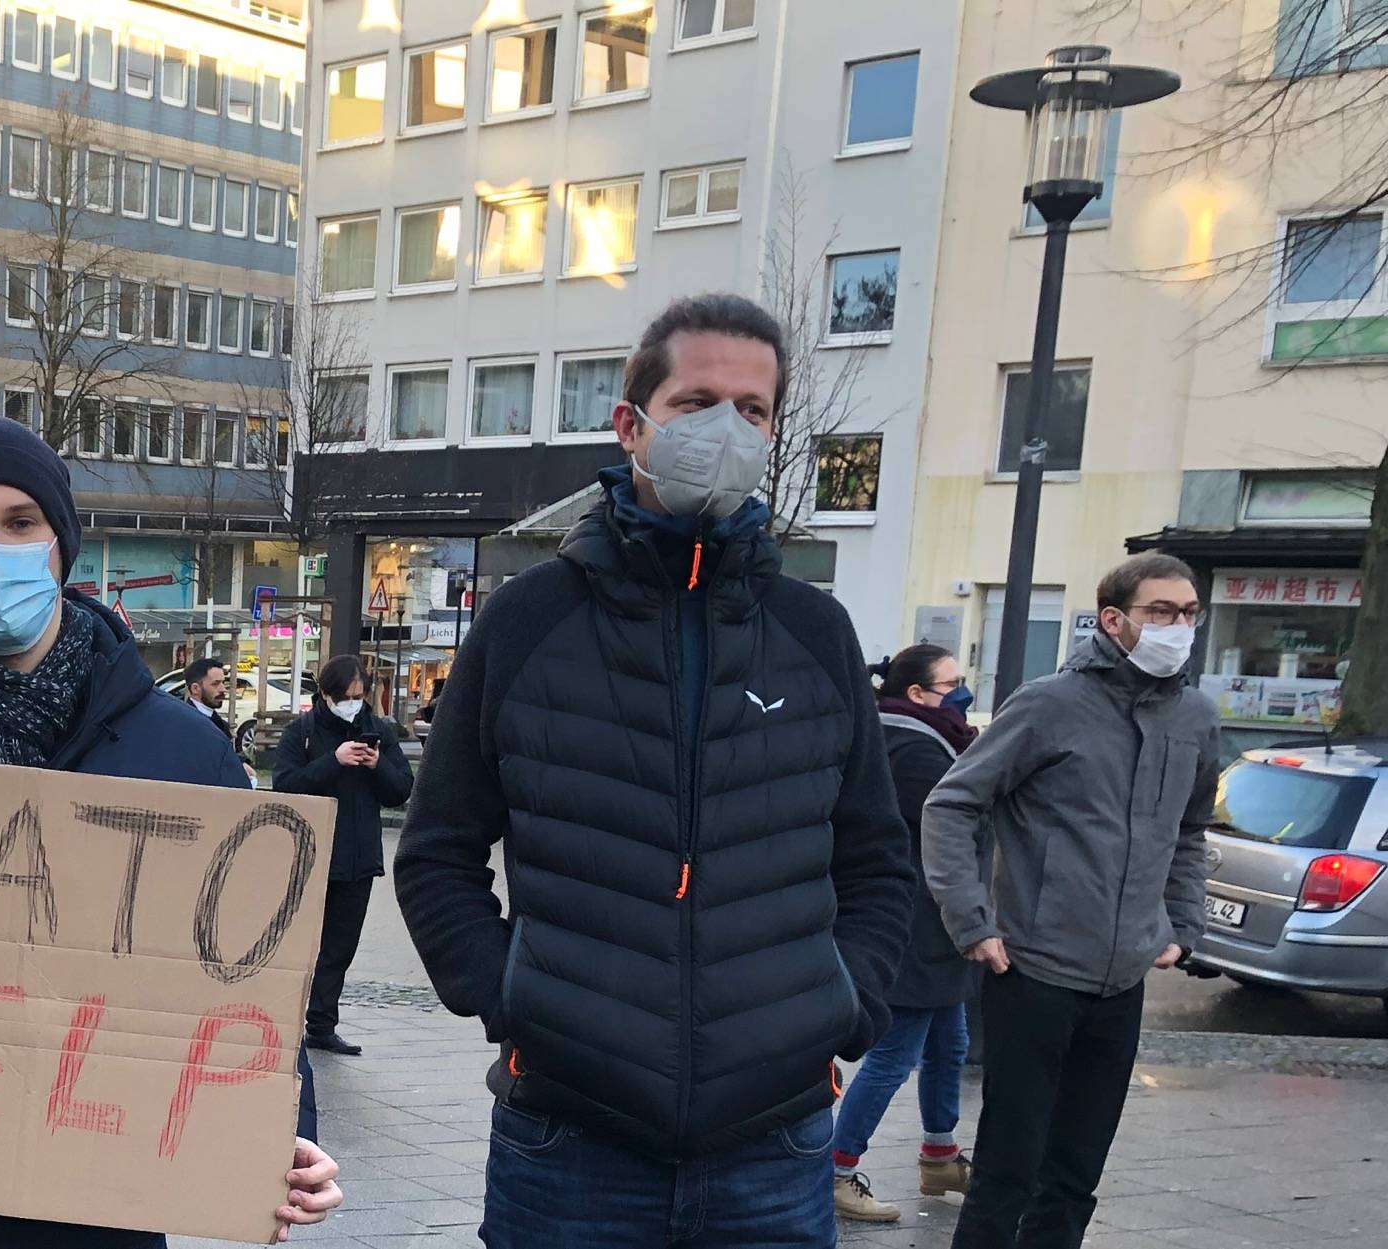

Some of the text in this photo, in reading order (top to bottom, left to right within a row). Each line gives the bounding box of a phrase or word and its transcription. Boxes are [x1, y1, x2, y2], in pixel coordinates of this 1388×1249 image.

[1225, 577, 1340, 602] 亚洲超市
[431, 628, 454, 637] Licht
[1220, 903, 1236, 920] 42
